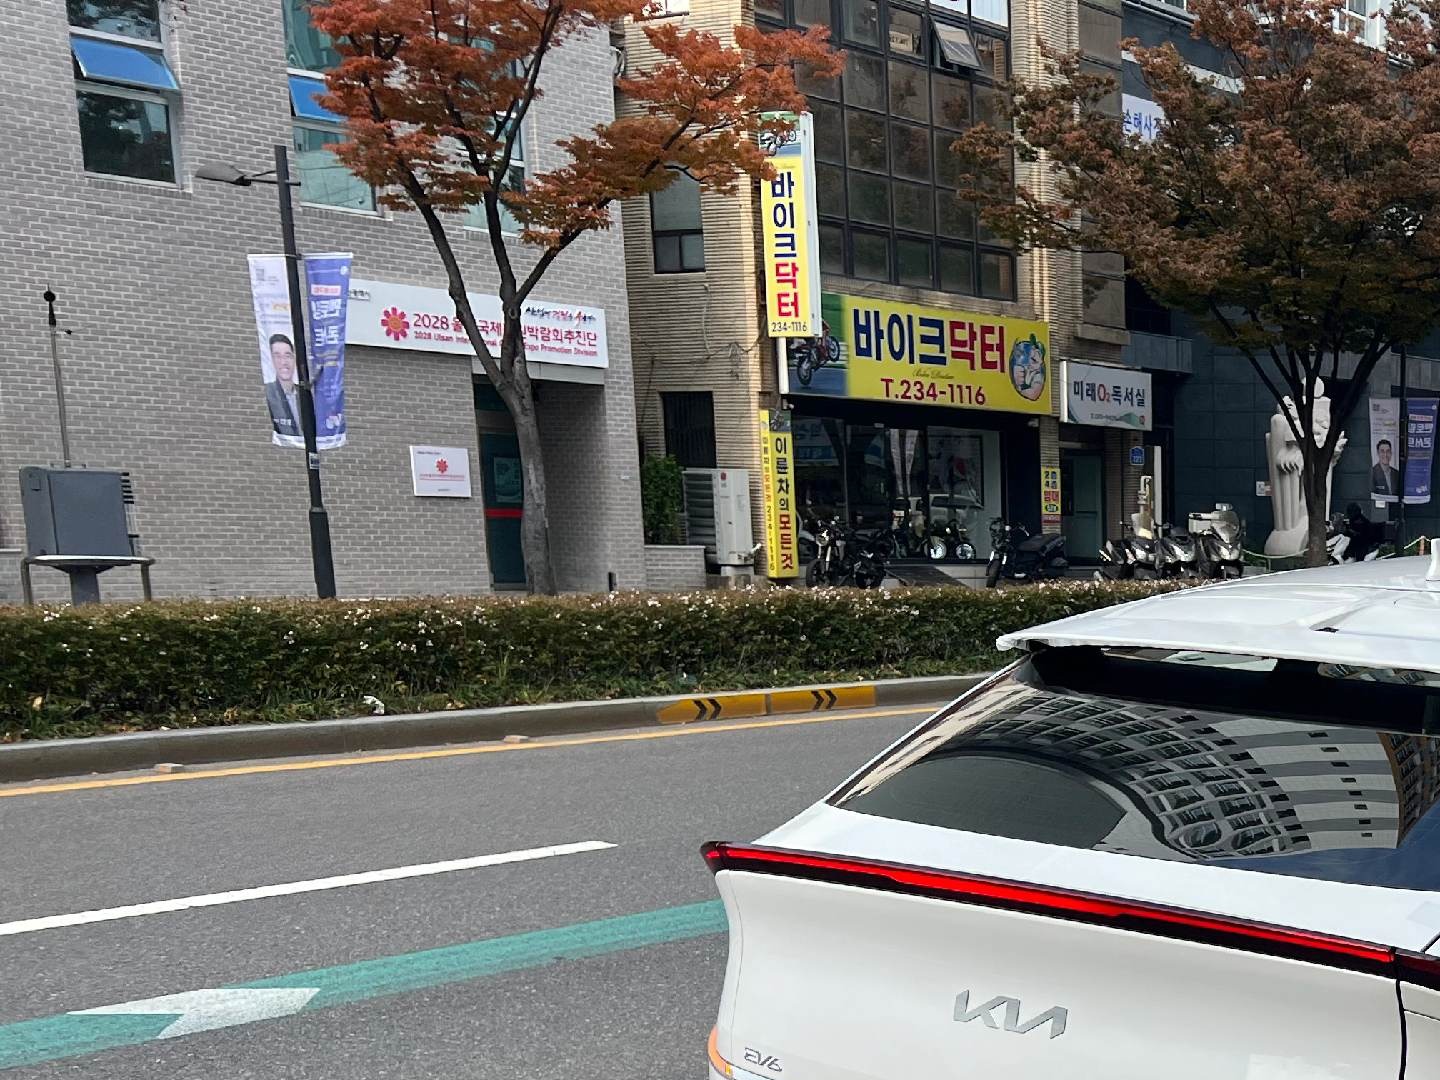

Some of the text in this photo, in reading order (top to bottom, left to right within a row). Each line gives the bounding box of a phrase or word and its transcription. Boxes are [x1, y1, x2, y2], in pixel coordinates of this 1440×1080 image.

[771, 171, 799, 318] 바이크닥터
[413, 313, 597, 346] 2028 울국제박람회추진단
[414, 330, 432, 340] 2028
[771, 321, 807, 332] 234-1116
[853, 308, 1005, 373] 바이크닥터
[880, 378, 985, 405] T.234-1116
[953, 989, 1068, 1040] KIA
[743, 1046, 783, 1073] EV6
